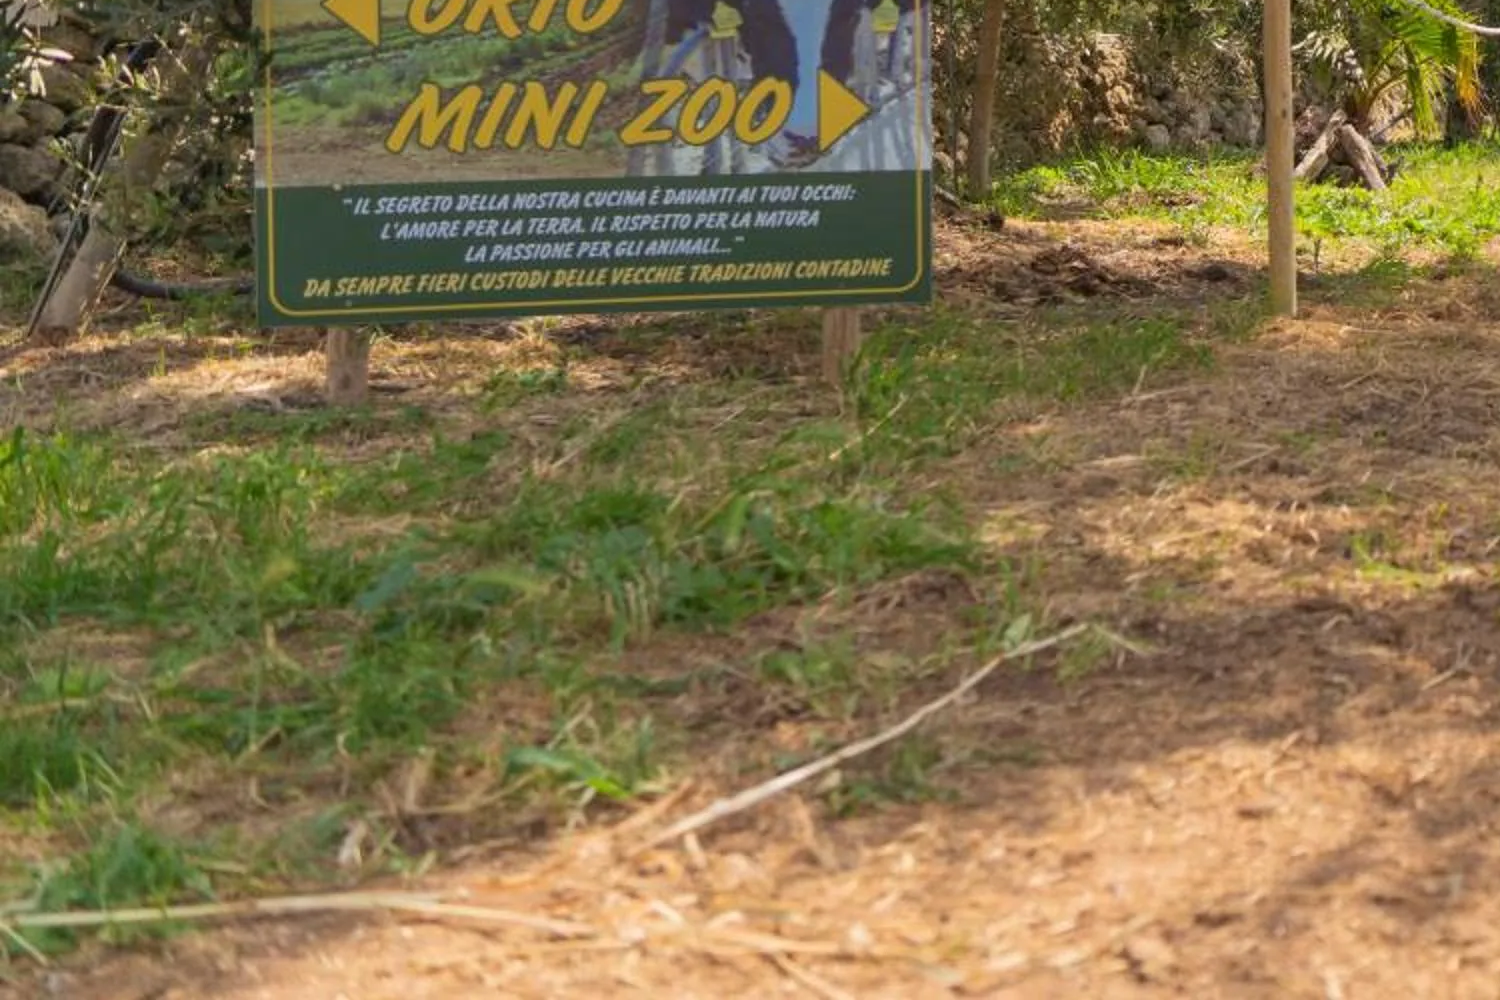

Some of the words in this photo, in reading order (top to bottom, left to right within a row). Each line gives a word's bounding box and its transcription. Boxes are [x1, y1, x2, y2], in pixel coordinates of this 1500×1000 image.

[384, 77, 608, 153] MINI
[619, 75, 793, 147] ZOO
[375, 195, 452, 214] SEGRETO
[456, 193, 508, 211] DELLA
[512, 191, 579, 210] NOSTRA
[585, 189, 644, 208] CUCINA
[649, 186, 662, 206] È
[664, 187, 737, 205] DAVANTI
[738, 186, 757, 203] AI
[760, 185, 800, 202] TUOI
[802, 184, 856, 201] OCCHI:
[381, 219, 460, 240] L'AMORE
[463, 219, 498, 237] PER
[501, 218, 524, 236] LA
[591, 215, 609, 233] IL
[610, 213, 691, 232] RISPETTO
[693, 212, 729, 230] PER
[731, 211, 751, 228] LA
[754, 210, 820, 227] NATURA
[465, 245, 487, 263] LA
[490, 241, 572, 261] PASSIONE
[576, 240, 612, 258] PER
[615, 239, 644, 257] GLI
[304, 278, 331, 298] DA
[335, 274, 413, 296] SEMPRE
[416, 273, 467, 293] FIERI
[470, 270, 549, 291] CUSTODI
[553, 267, 608, 288] DELLE
[610, 265, 686, 285] VECCHIE
[688, 261, 793, 283] TRADIZIONI
[794, 258, 893, 278] CONTADINE
